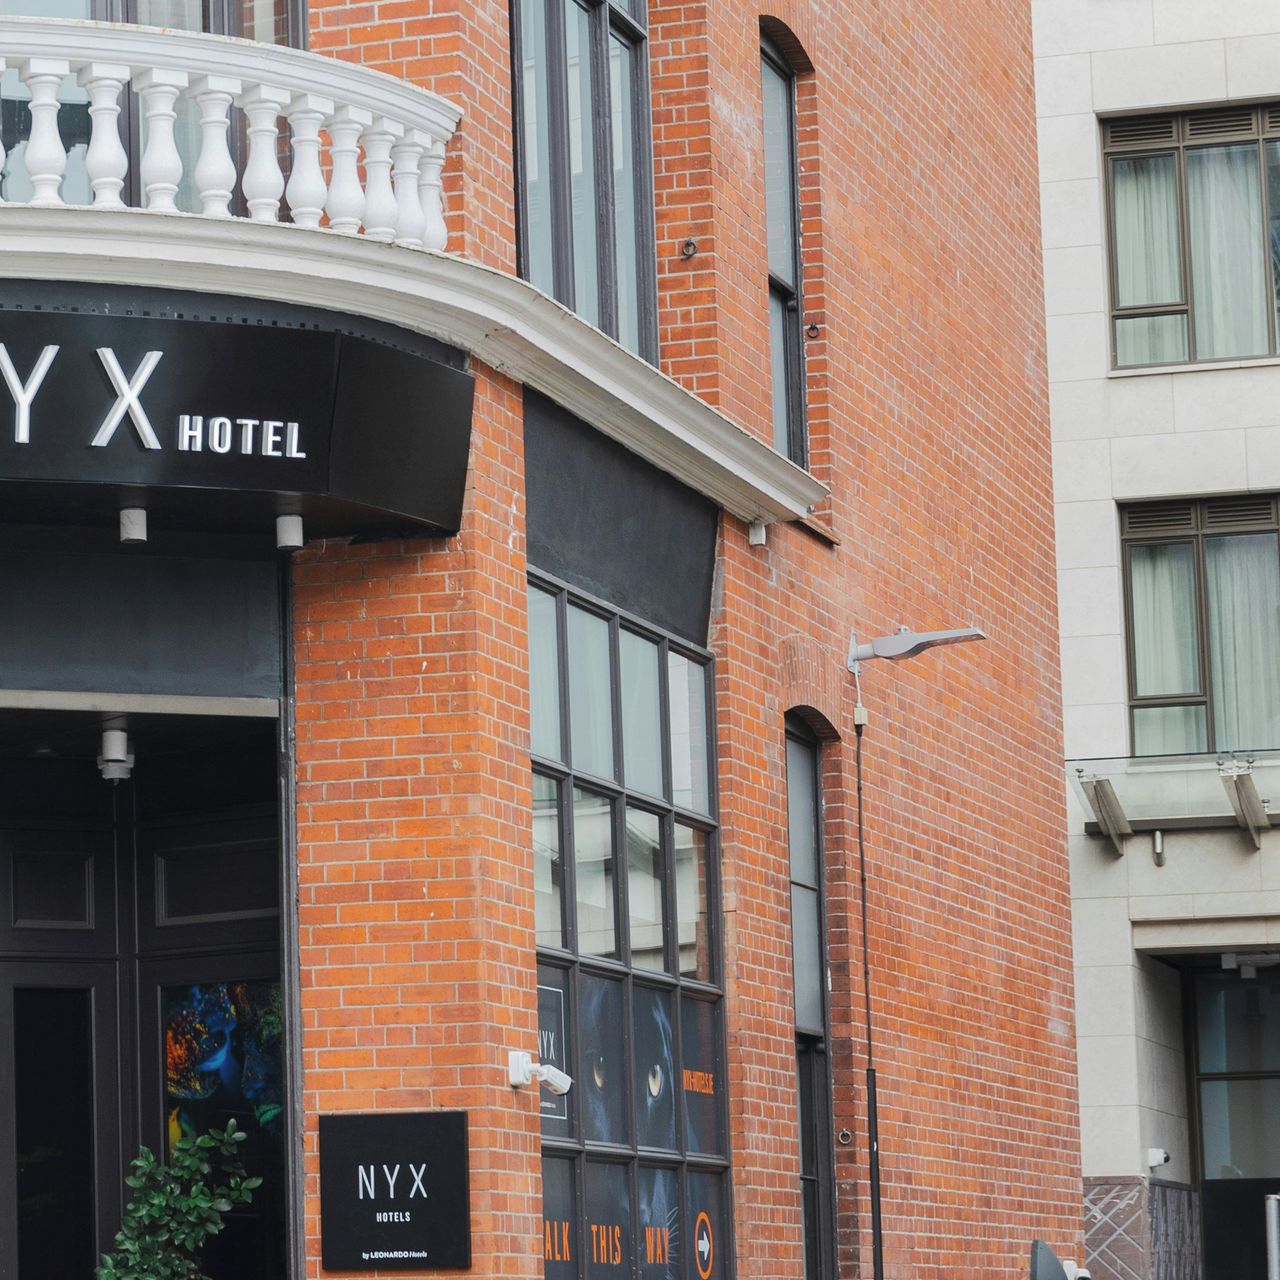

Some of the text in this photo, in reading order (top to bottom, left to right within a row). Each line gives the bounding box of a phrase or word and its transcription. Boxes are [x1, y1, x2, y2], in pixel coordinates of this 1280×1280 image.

[177, 413, 307, 459] HOTEL
[358, 1163, 428, 1200] NYX
[376, 1211, 411, 1222] HOTELS
[362, 1251, 370, 1260] by
[370, 1251, 409, 1259] LEONARDO
[545, 1220, 669, 1265] ALK THIS WAY
